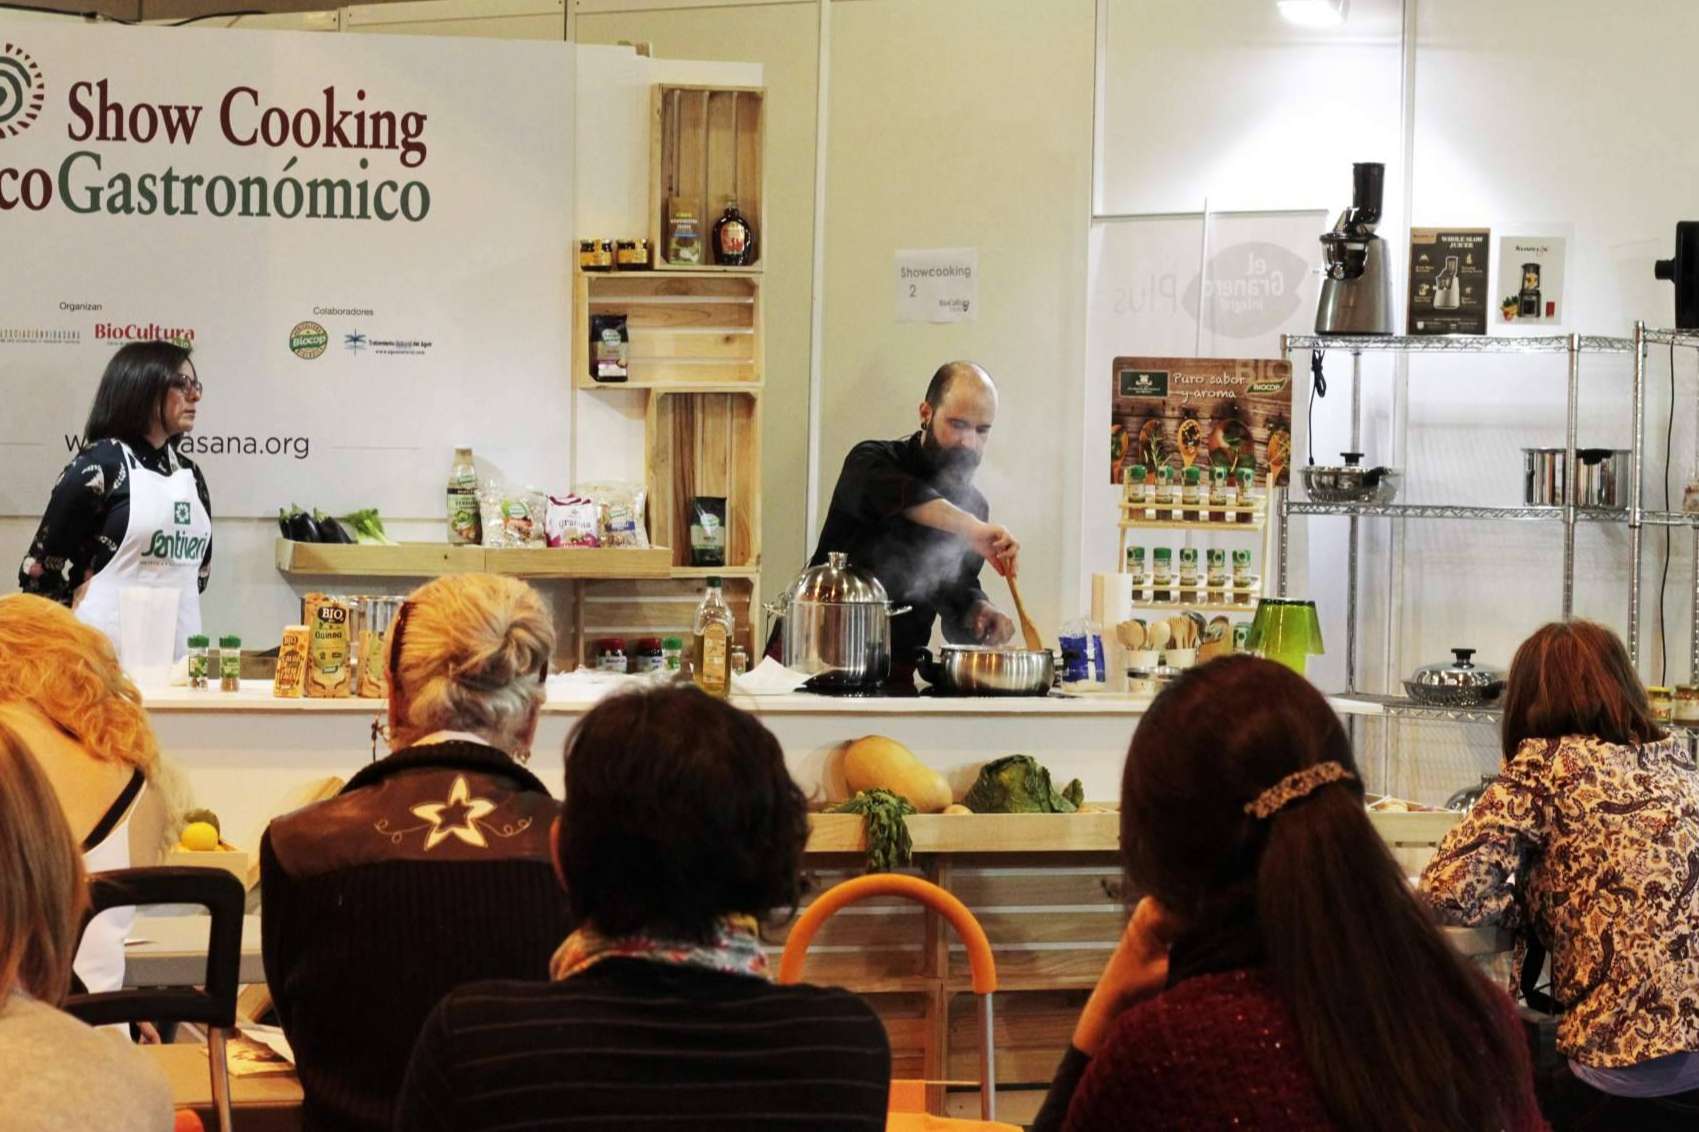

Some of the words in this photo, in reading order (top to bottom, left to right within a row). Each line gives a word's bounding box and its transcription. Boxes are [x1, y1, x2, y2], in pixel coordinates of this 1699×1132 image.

[67, 78, 203, 145] Show
[219, 85, 428, 168] Cooking
[900, 264, 972, 279] Showcooking
[909, 283, 918, 298] 2
[59, 301, 103, 312] Organizan
[313, 306, 374, 317] Colaboradores
[94, 323, 195, 341] BioCultura
[1172, 372, 1205, 386] Puro
[1207, 374, 1247, 386] sabor
[1191, 390, 1237, 400] aroma
[140, 529, 208, 560] Santiveri
[321, 607, 344, 619] BIO
